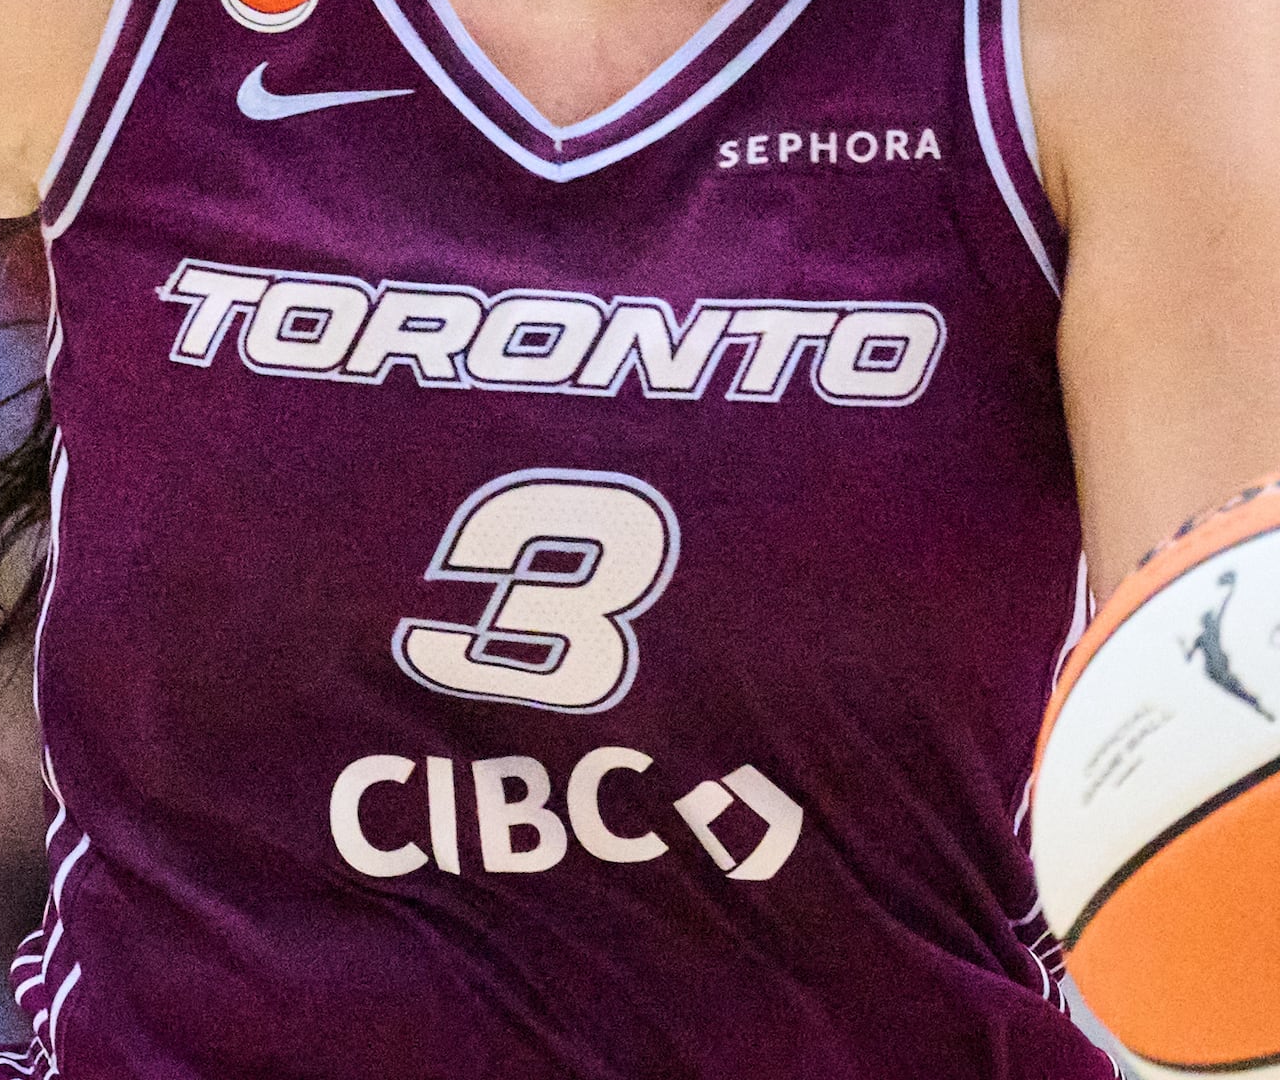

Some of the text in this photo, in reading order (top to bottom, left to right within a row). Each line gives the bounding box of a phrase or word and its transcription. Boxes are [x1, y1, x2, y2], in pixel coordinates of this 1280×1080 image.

[718, 128, 942, 169] SEPHORA
[155, 258, 947, 408] TORONTO
[391, 467, 681, 715] 3
[329, 746, 669, 878] CIBC
